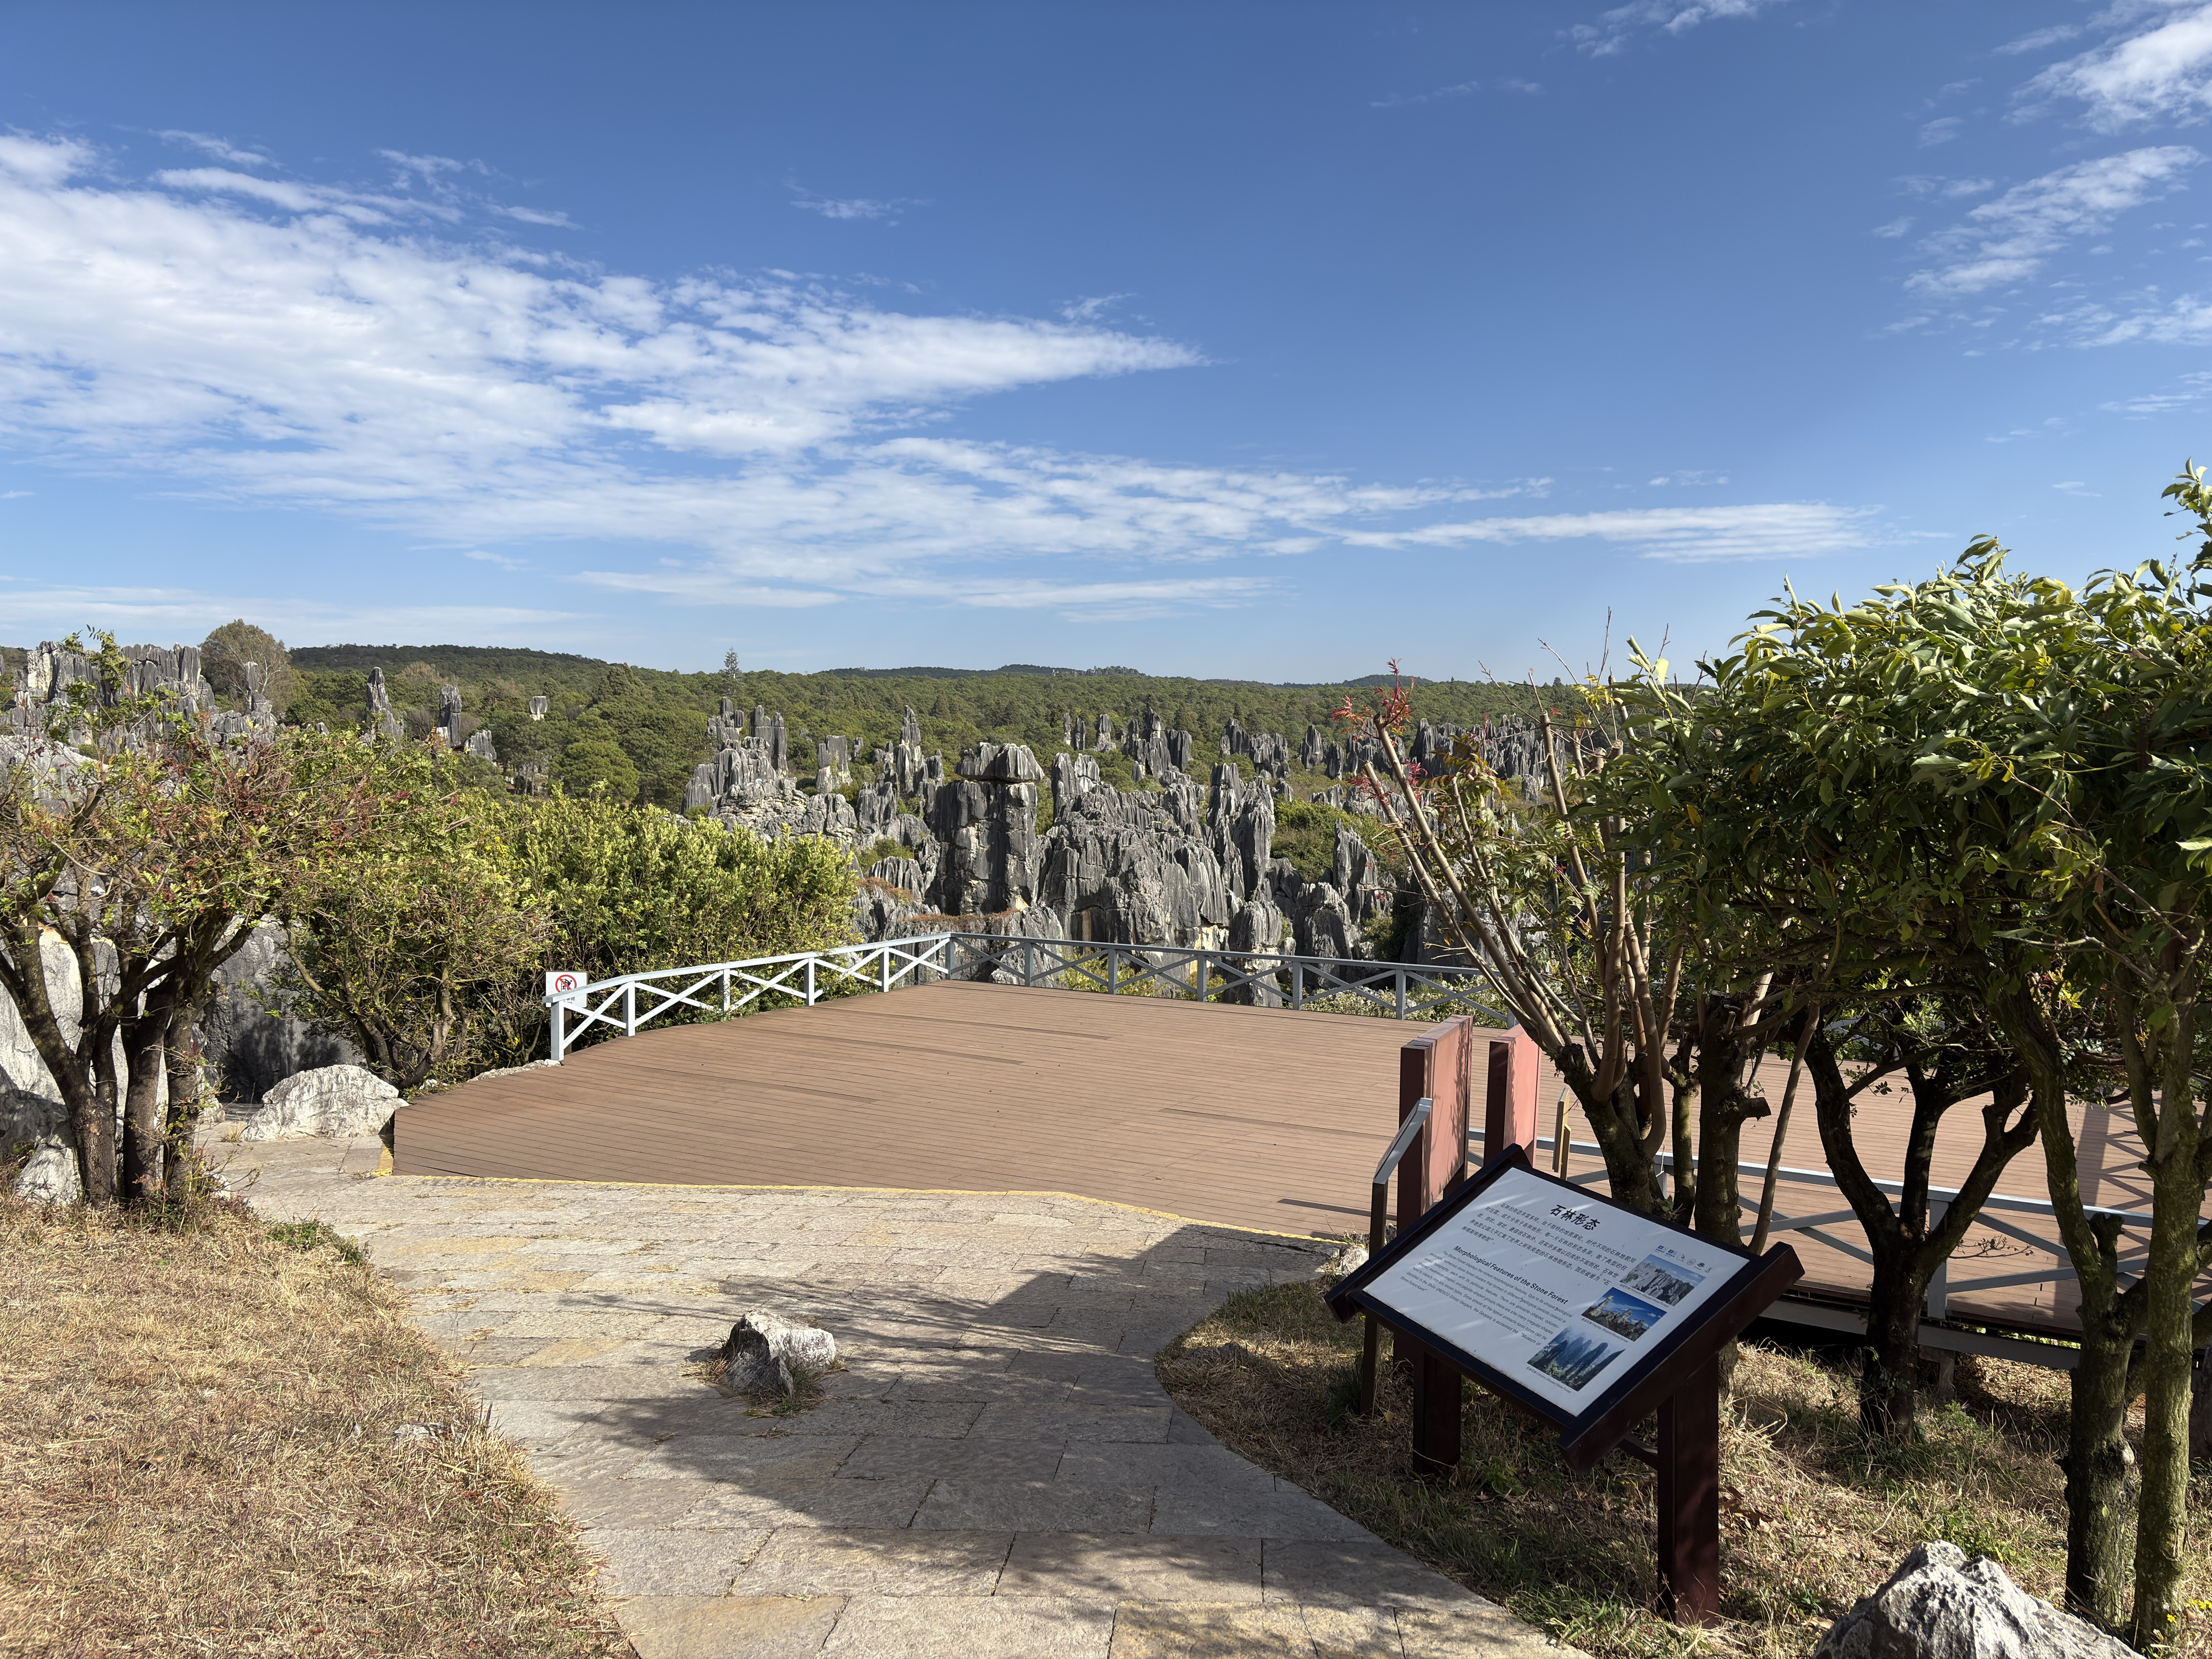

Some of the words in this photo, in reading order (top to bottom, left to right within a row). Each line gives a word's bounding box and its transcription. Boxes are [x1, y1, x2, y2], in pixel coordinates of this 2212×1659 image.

[1550, 1204, 1600, 1230] 石林形态
[1453, 1245, 1492, 1266] Morphological
[1490, 1264, 1514, 1278] Features
[1530, 1283, 1548, 1295] Stone
[1547, 1291, 1568, 1304] Forest
[1406, 1271, 1420, 1280] identified
[1436, 1287, 1450, 1296] UNESCO
[1479, 1311, 1493, 1319] Geopark
[1495, 1320, 1513, 1331] acclaimed
[1469, 1281, 1485, 1290] particular
[1545, 1319, 1559, 1328] column-
[1492, 1276, 1515, 1288] morphological
[1554, 1307, 1573, 1317] geological
[1506, 1292, 1522, 1300] different
[1519, 1297, 1538, 1308] geological
[1501, 1315, 1517, 1324] pinnacle
